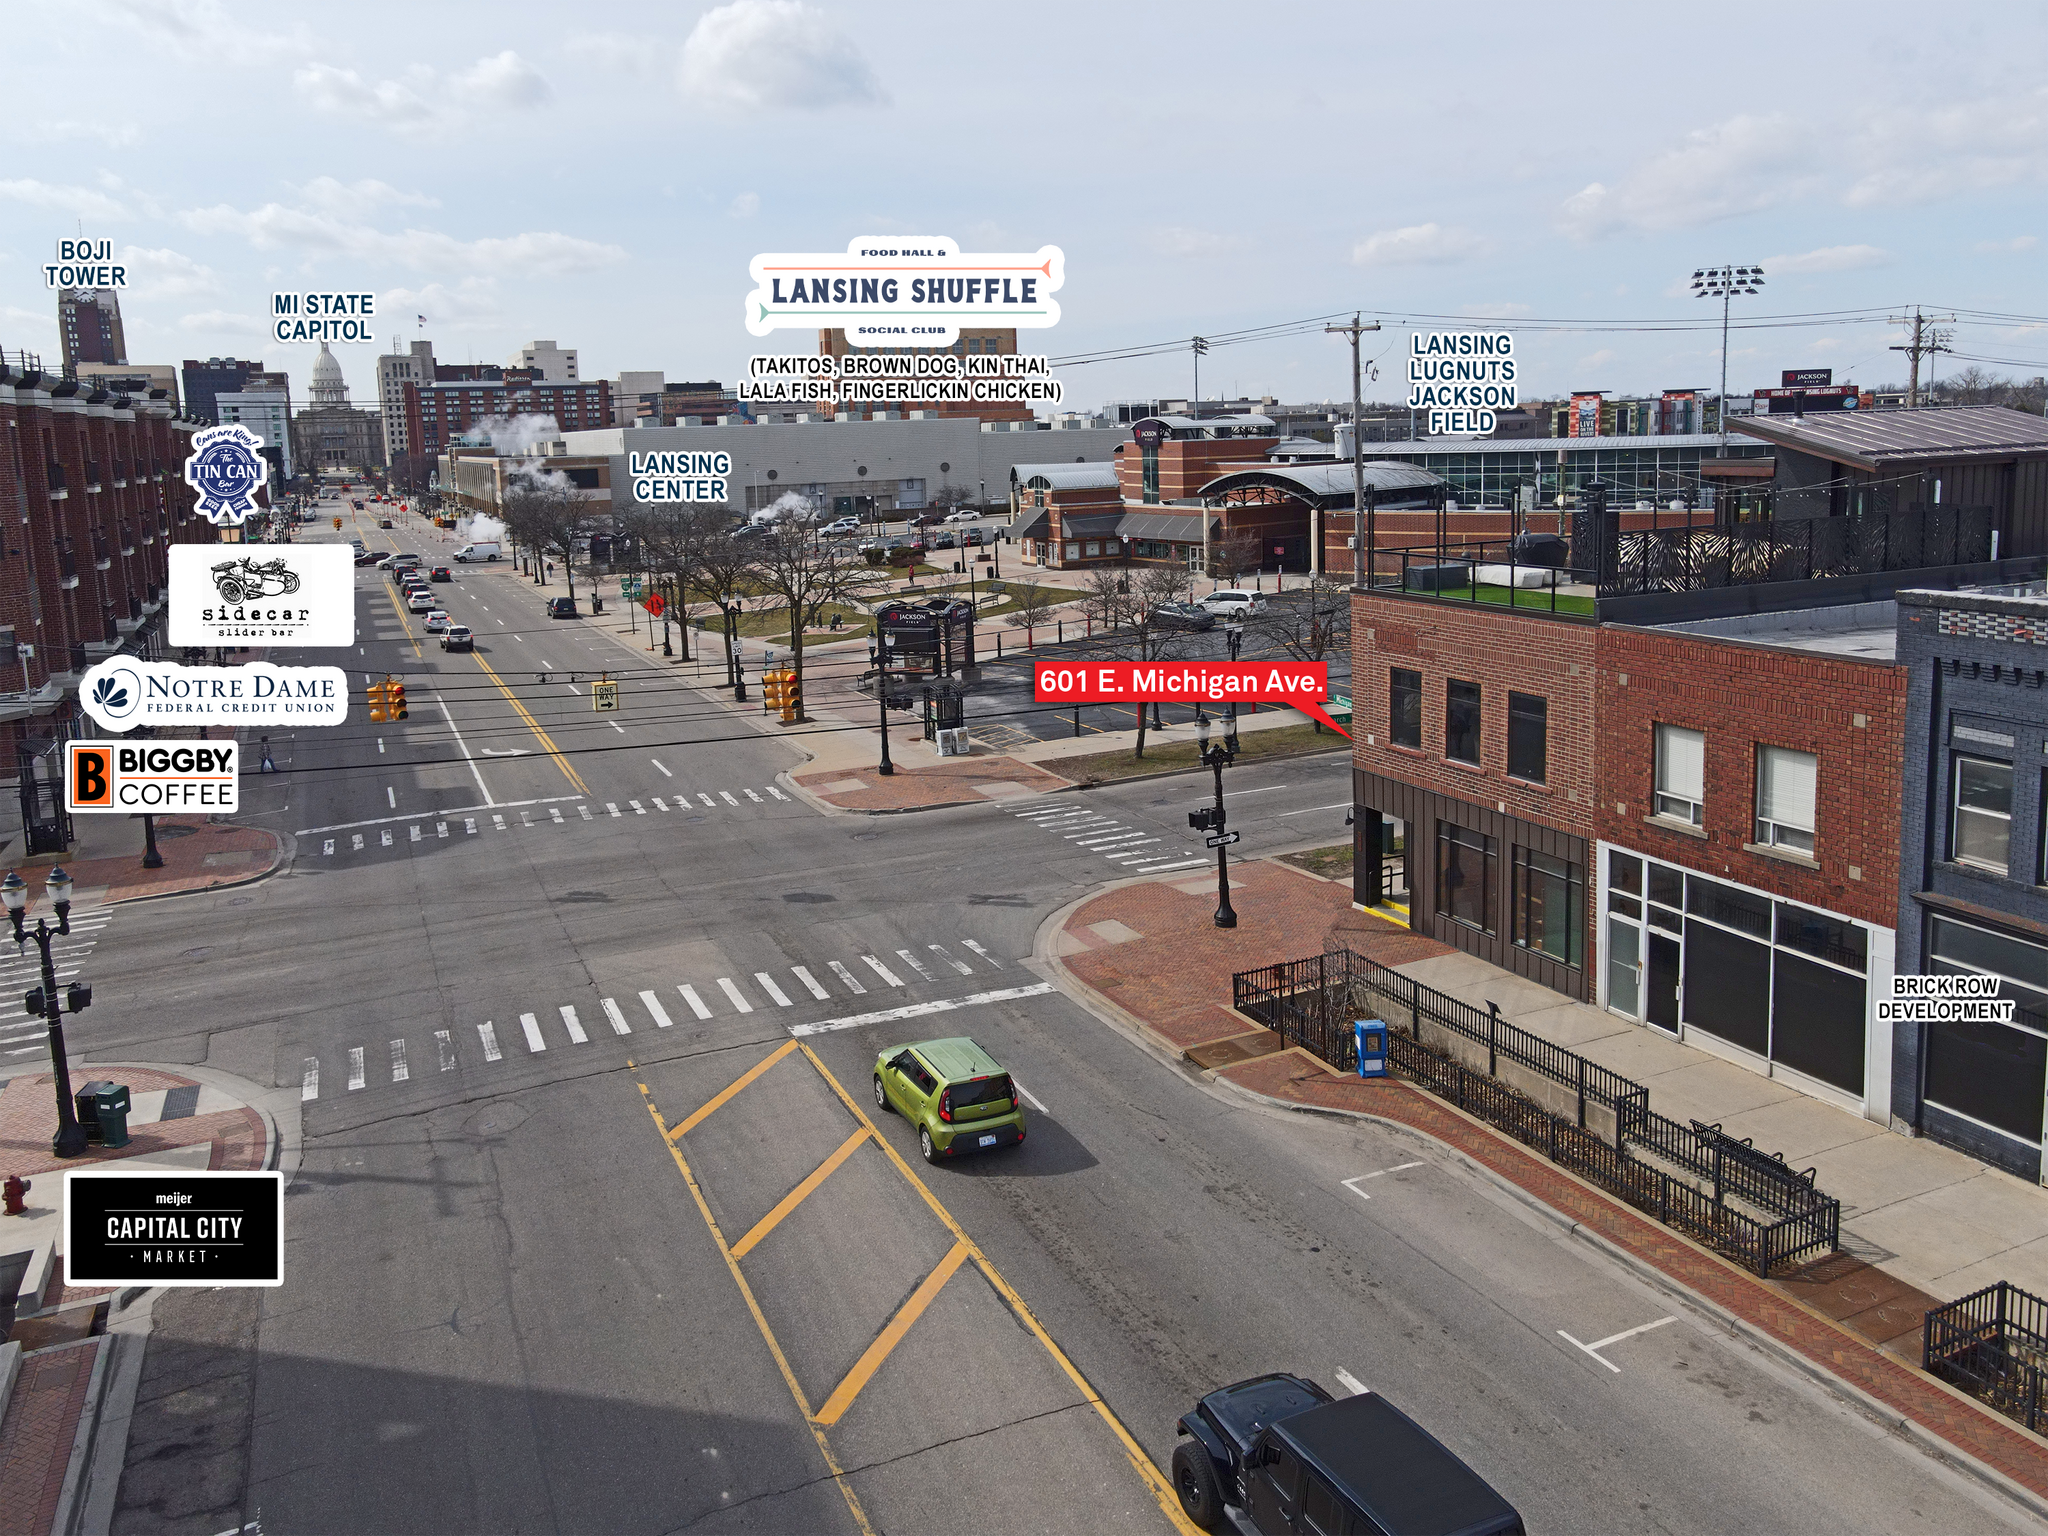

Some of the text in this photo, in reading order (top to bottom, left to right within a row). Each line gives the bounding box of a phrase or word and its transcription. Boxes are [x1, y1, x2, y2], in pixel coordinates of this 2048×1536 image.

[1797, 373, 1827, 381] JACKSON
[1580, 420, 1595, 428] LIVE
[899, 613, 927, 621] JACKSON
[732, 647, 742, 655] 30
[599, 693, 615, 701] WAY
